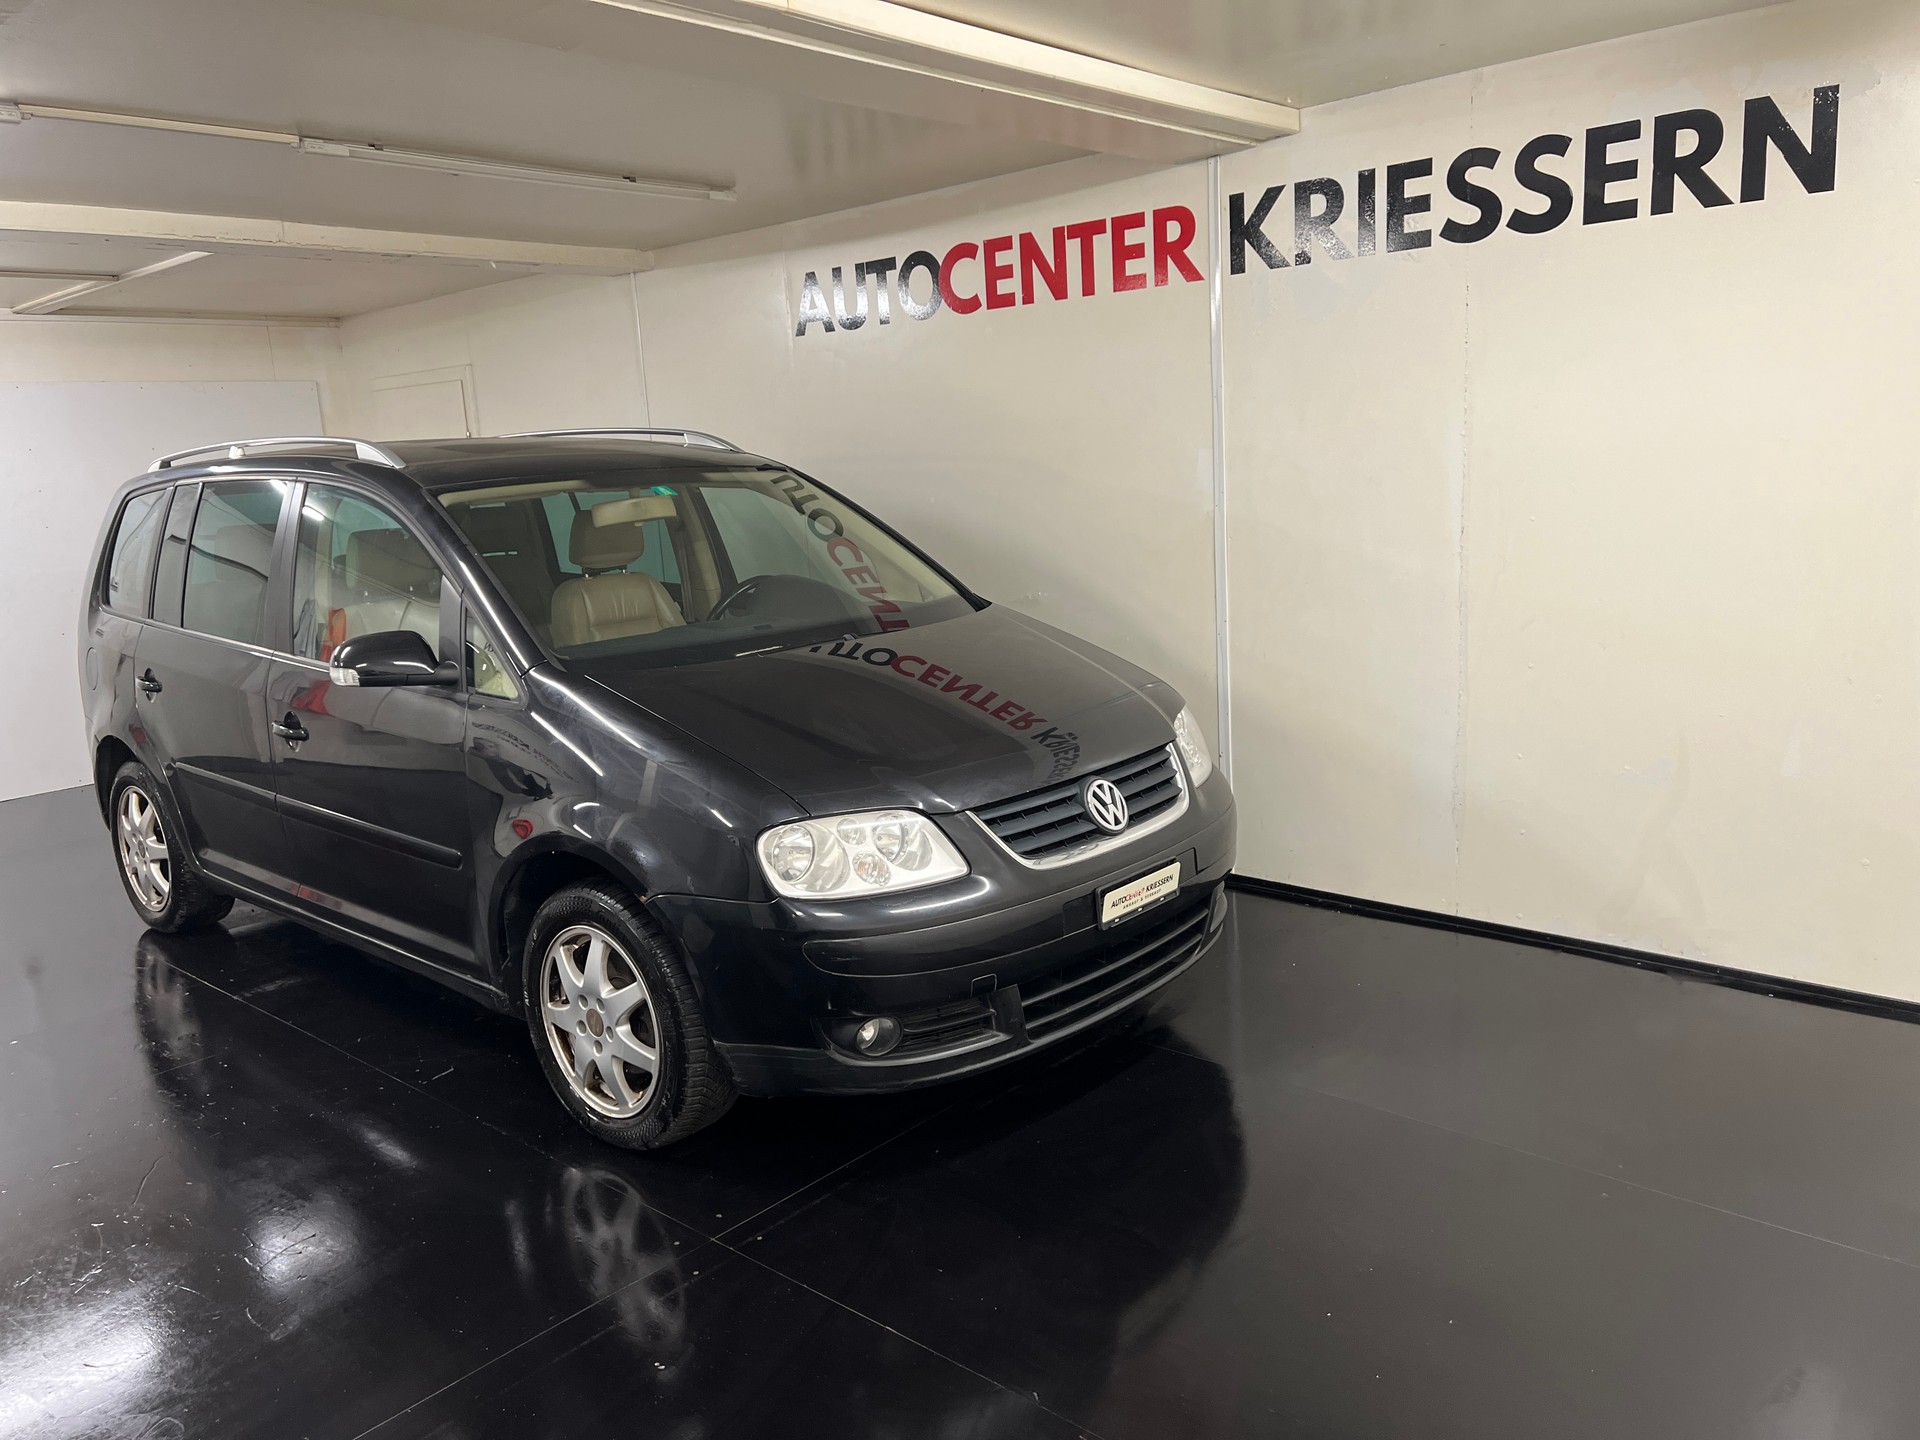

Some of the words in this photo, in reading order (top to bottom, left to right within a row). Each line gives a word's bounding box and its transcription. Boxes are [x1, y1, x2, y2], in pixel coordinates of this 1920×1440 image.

[795, 205, 1205, 337] AUTOCENTER
[1229, 84, 1841, 275] KRIESSERN
[1087, 780, 1128, 831] VW
[1145, 874, 1174, 893] KRIESSERN
